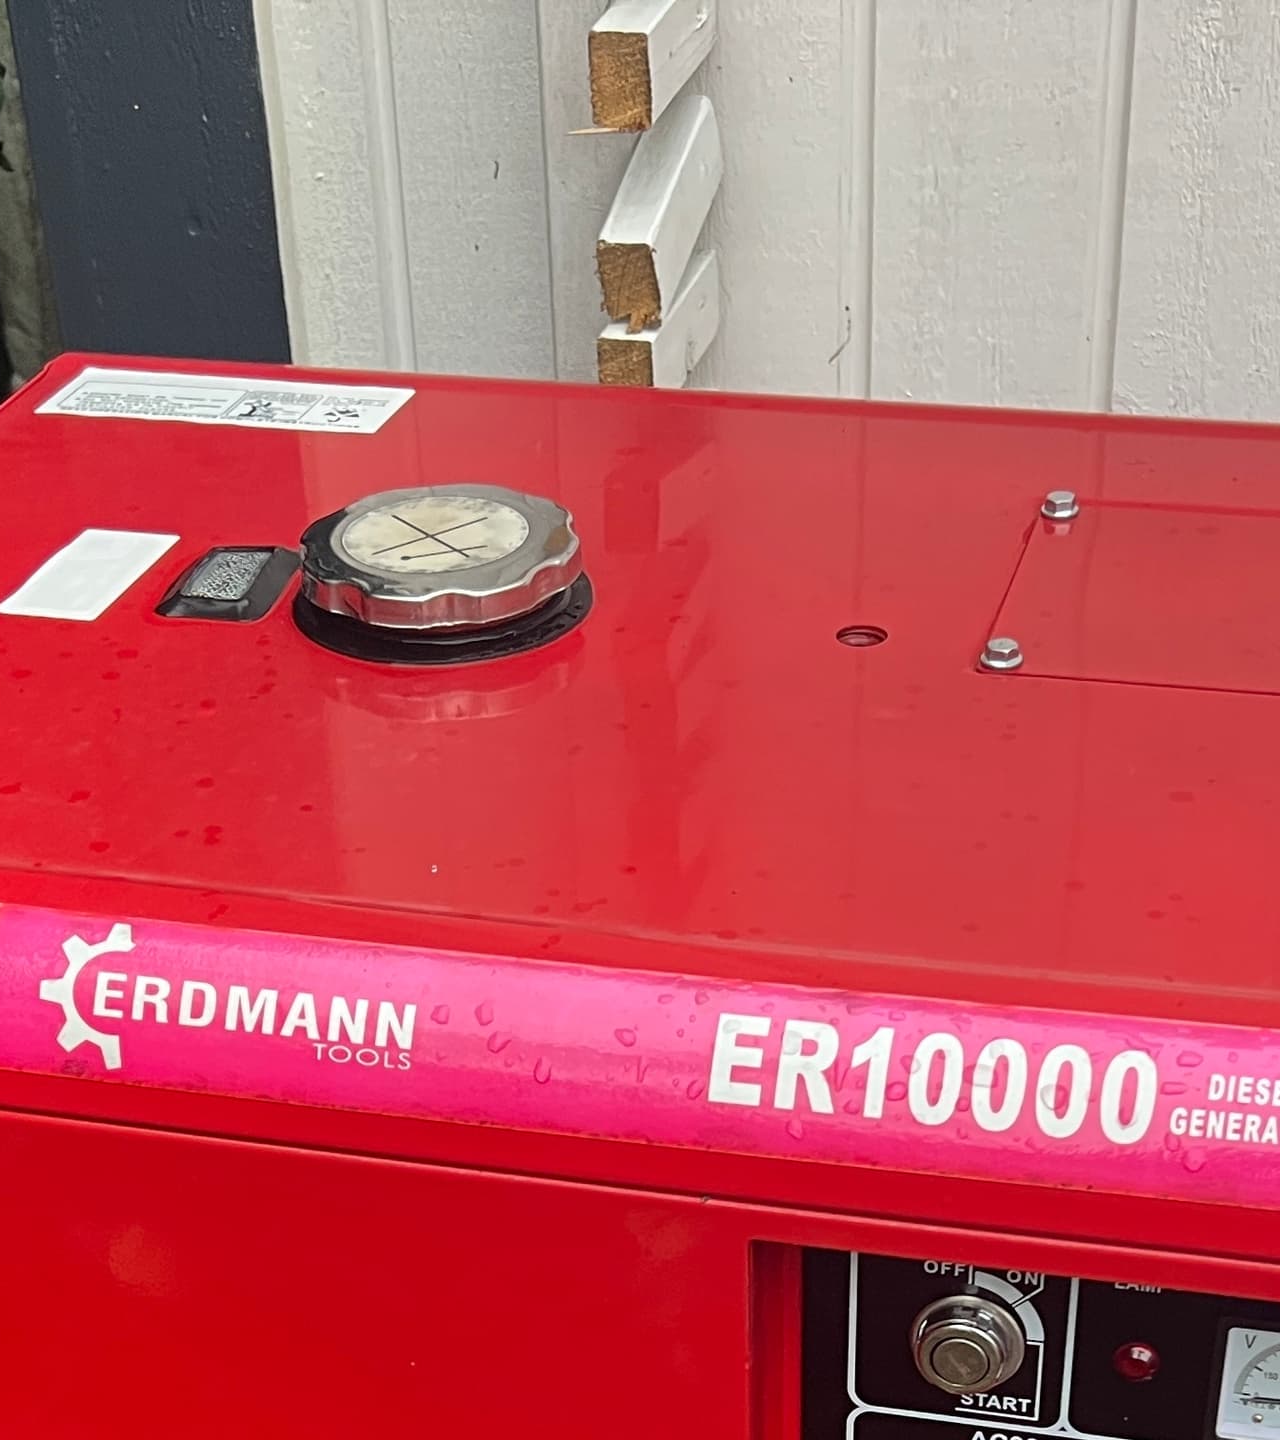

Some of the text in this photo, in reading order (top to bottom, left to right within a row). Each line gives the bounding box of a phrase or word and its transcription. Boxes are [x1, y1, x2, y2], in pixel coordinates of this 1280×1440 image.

[92, 970, 418, 1051] ERDMANN
[312, 1041, 412, 1071] TOOLS
[707, 1012, 1158, 1146] ER10000
[923, 1259, 966, 1277] OFF
[1006, 1270, 1039, 1286] ON
[1244, 1334, 1257, 1349] V
[960, 1392, 1032, 1413] START
